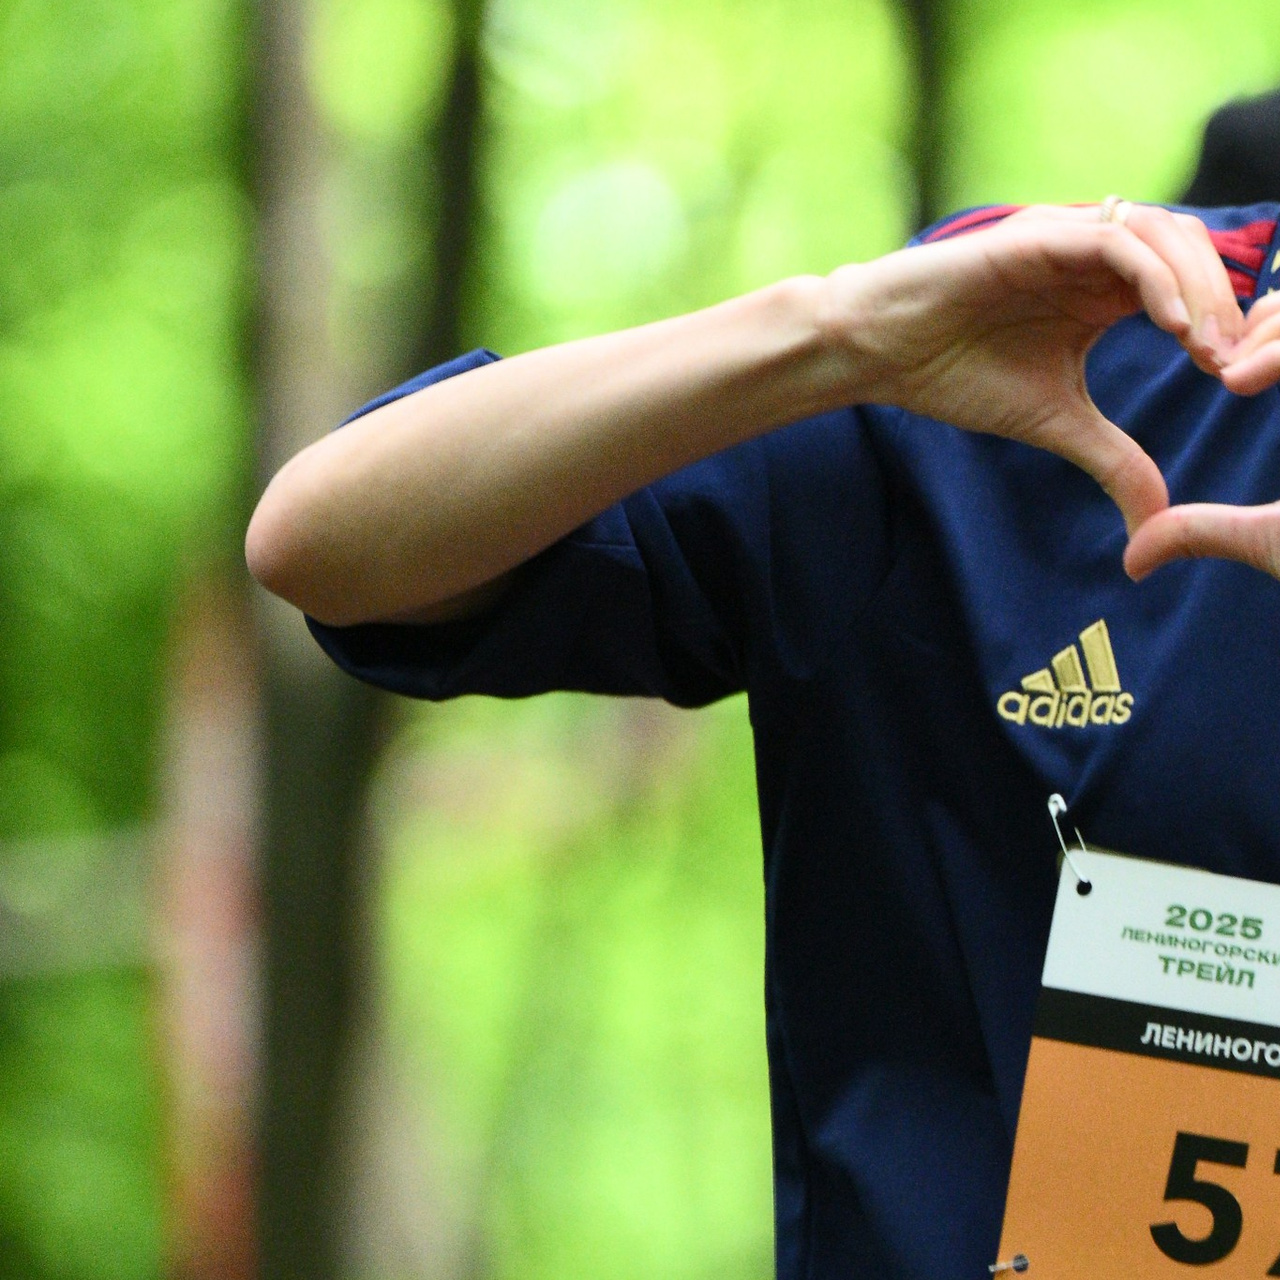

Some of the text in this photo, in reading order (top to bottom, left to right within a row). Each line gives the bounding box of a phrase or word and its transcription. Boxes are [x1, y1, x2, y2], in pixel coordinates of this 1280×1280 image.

[996, 688, 1134, 729] adidas
[1164, 904, 1264, 940] 2025
[1158, 953, 1256, 989] ТРЕЙЛ
